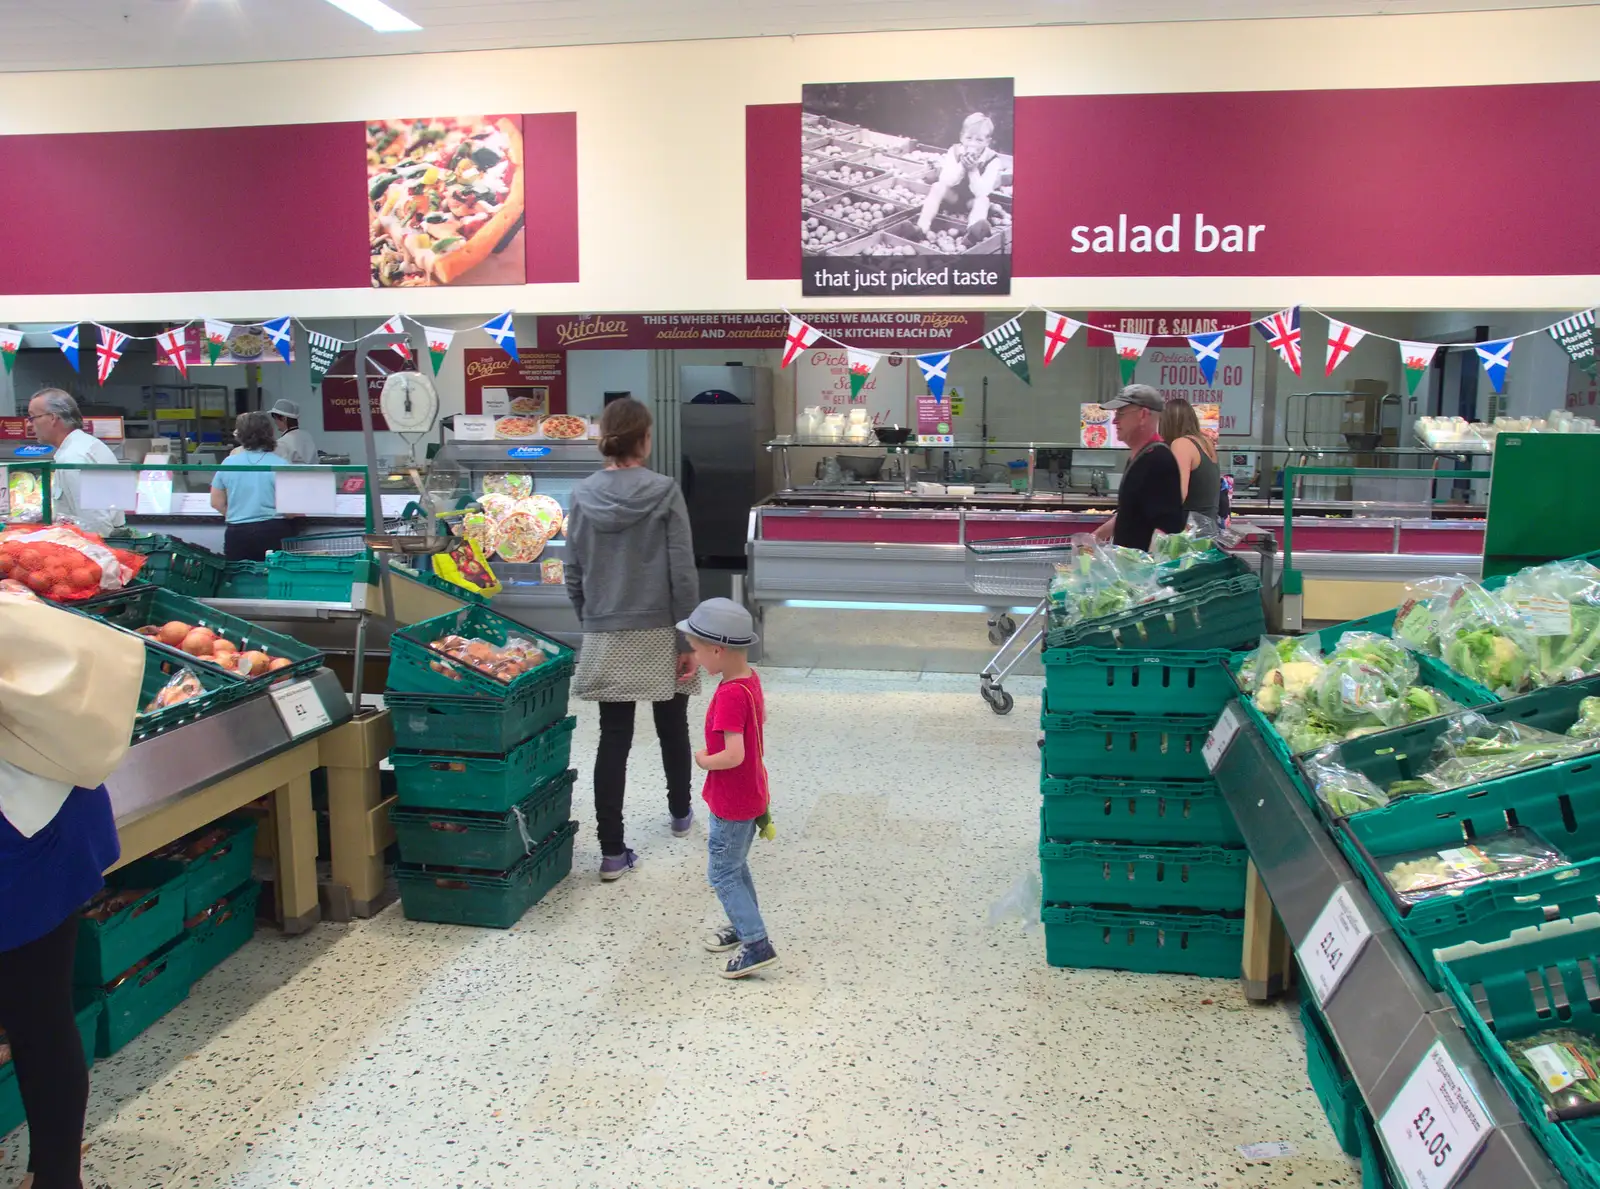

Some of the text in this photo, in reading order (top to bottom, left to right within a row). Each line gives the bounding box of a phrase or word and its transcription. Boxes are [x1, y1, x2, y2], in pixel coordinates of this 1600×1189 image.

[1070, 213, 1266, 253] salad bar
[814, 266, 999, 292] that just picked taste
[642, 313, 968, 328] THIS IS WHERE THE MAGIC HPPENS! WE MAKE OUR pizzas,
[1120, 318, 1218, 335] FRUIT & SALADS
[556, 315, 629, 345] Kitchen
[656, 327, 699, 340] salads
[700, 328, 725, 339] AND
[845, 327, 894, 338] KITCHEN
[896, 327, 927, 338] EACH
[928, 327, 953, 338] DAY
[1561, 329, 1592, 346] Market
[995, 337, 1021, 354] Market
[1000, 345, 1024, 361] Street
[1566, 338, 1594, 353] Street
[1571, 347, 1595, 361] Party
[466, 357, 513, 376] Pizzas!
[1005, 353, 1026, 368] Party
[1160, 365, 1207, 386] FOODS
[1224, 365, 1243, 386] GO
[1192, 389, 1223, 403] FRESH
[295, 704, 307, 716] £1
[1320, 931, 1343, 971] £1.41
[1412, 1106, 1453, 1168] £1.05
